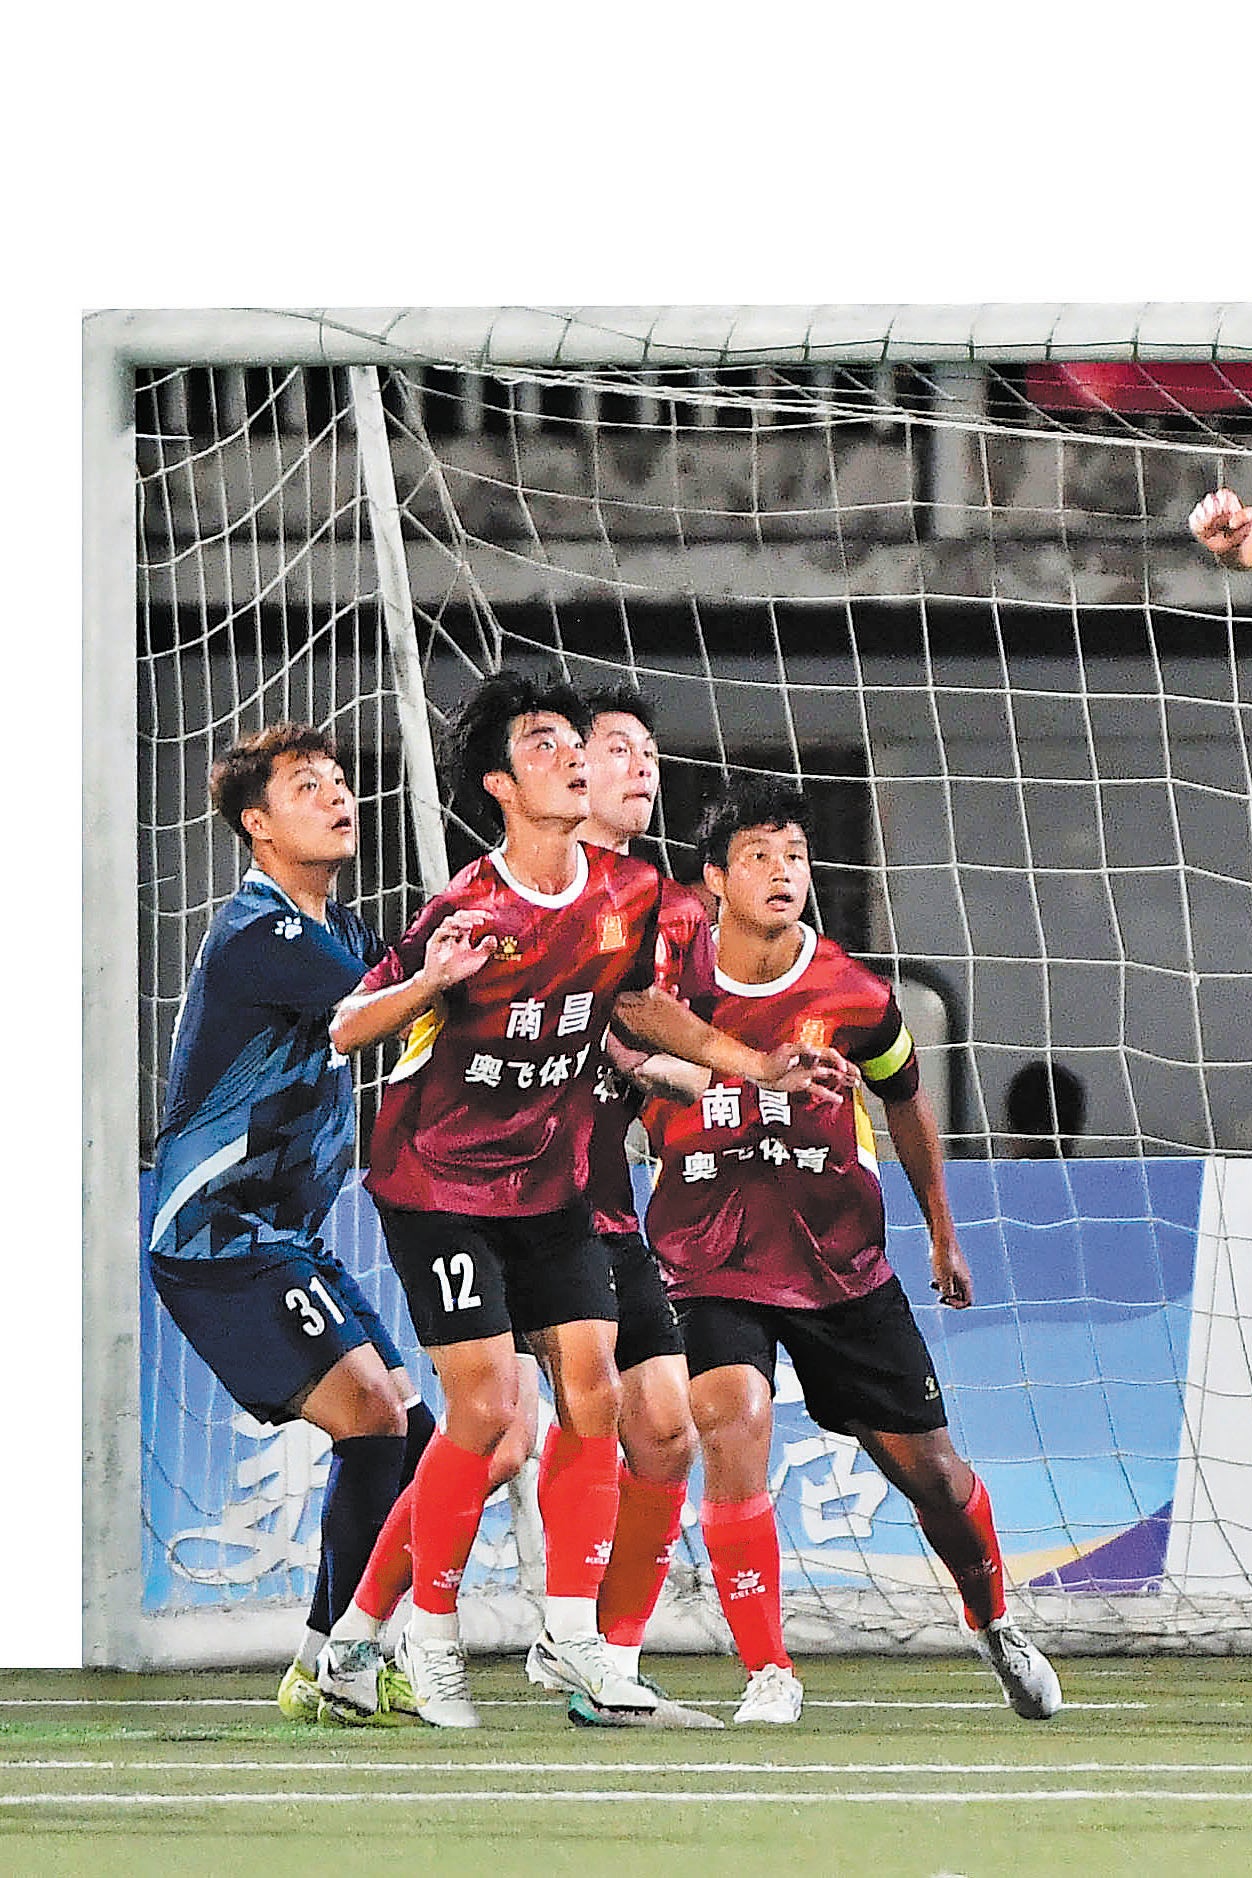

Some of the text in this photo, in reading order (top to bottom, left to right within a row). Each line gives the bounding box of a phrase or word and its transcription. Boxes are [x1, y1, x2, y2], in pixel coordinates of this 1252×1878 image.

[505, 990, 595, 1042] 南昌
[464, 1041, 591, 1088] 奥飞体
[701, 1082, 792, 1130] 南昌
[285, 1274, 346, 1337] 31
[431, 1252, 482, 1313] 12
